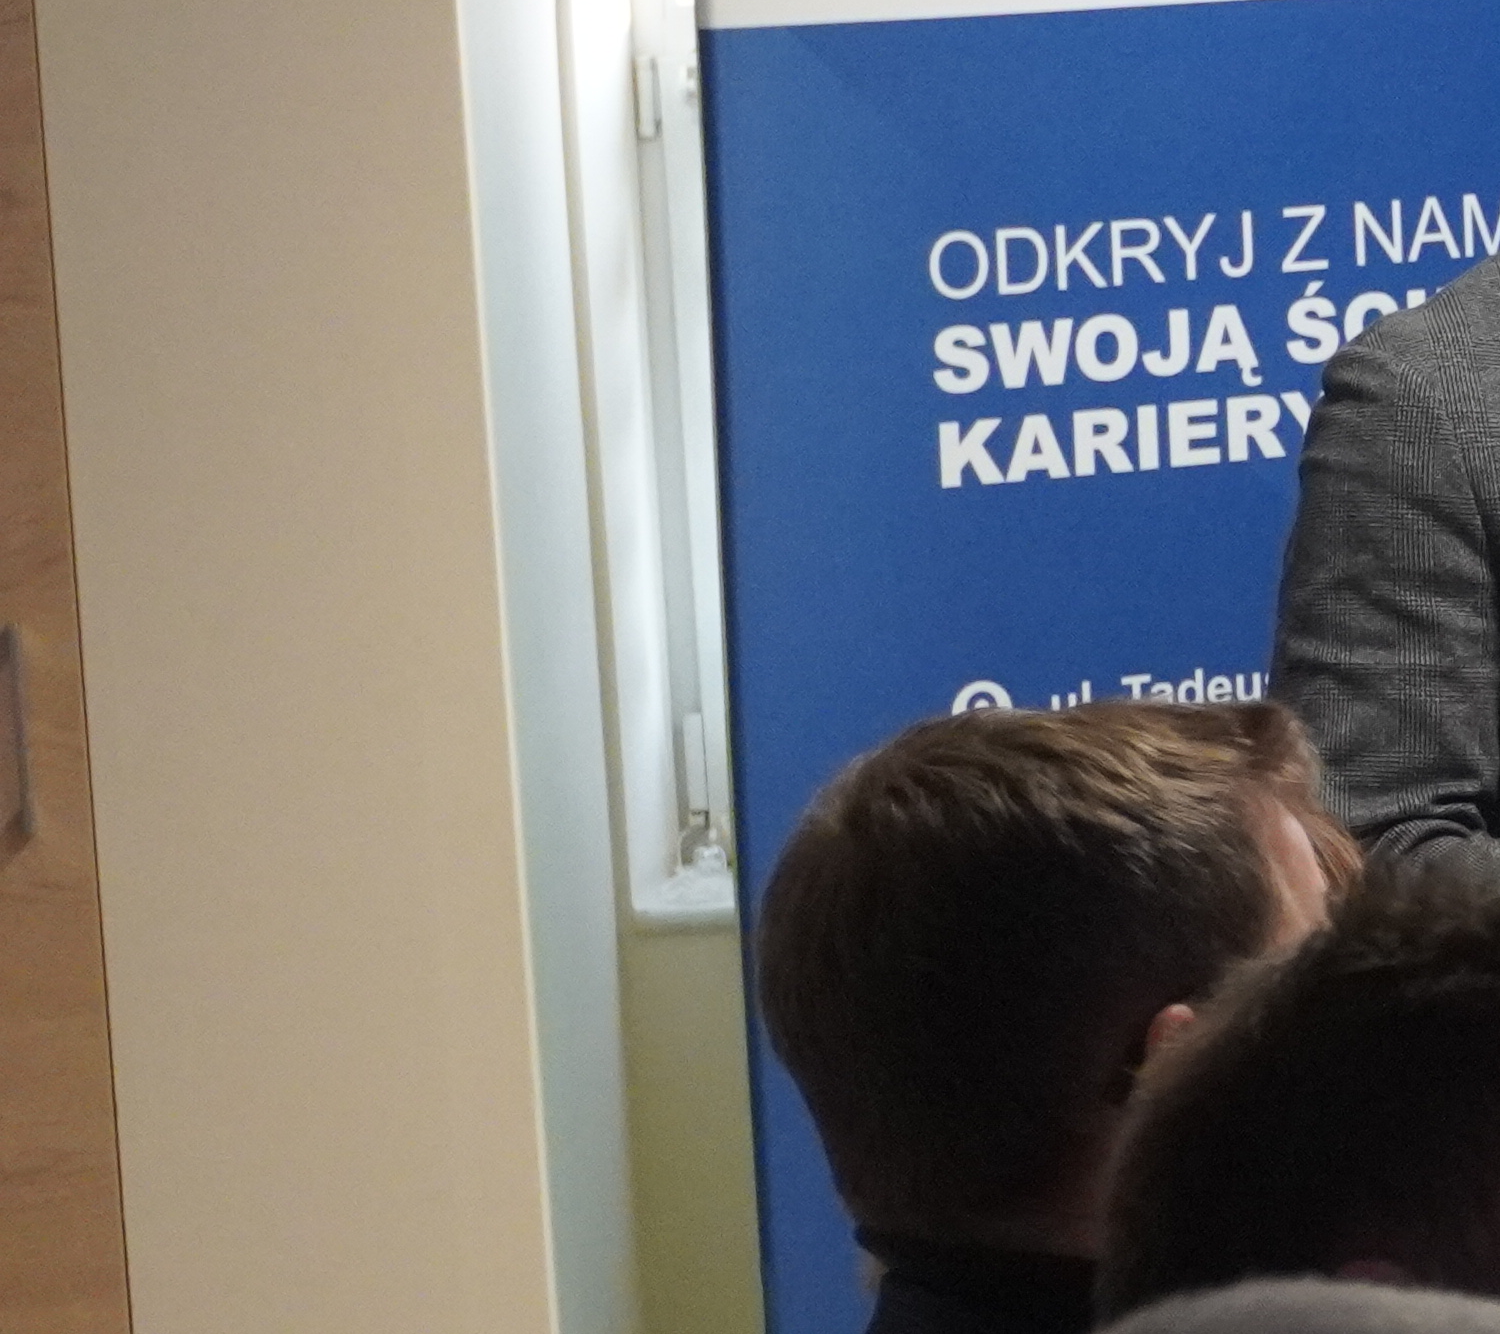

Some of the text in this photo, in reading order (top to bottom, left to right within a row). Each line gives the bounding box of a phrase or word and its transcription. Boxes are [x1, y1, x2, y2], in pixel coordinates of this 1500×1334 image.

[929, 210, 1254, 300] ODKRYJ
[1281, 204, 1329, 273] Z
[933, 304, 1263, 395] SWOJĄ
[1120, 668, 1270, 703] Tadeu
